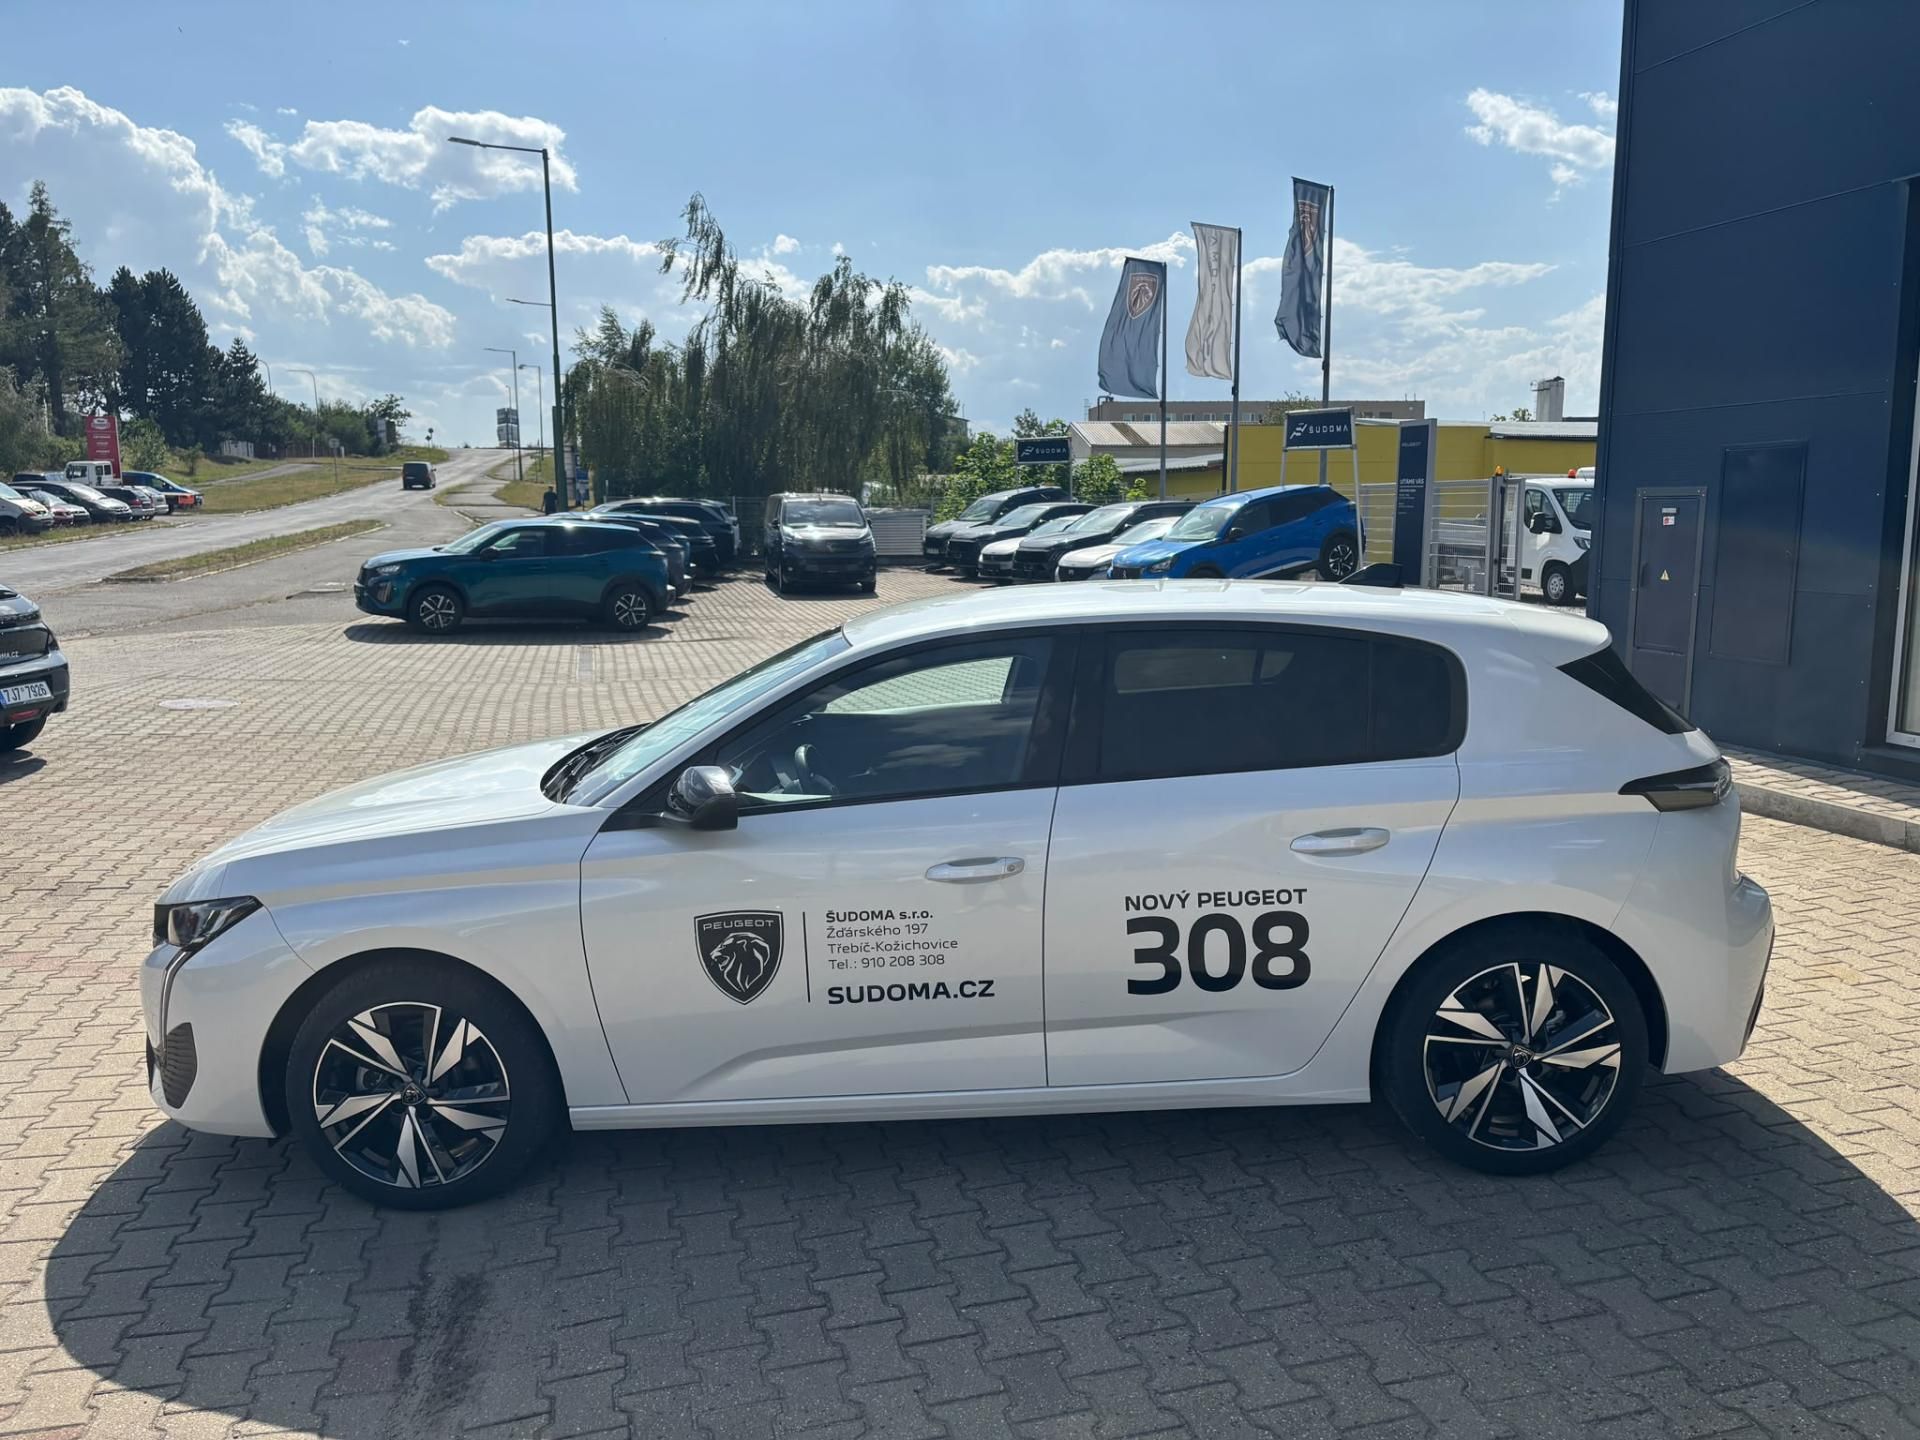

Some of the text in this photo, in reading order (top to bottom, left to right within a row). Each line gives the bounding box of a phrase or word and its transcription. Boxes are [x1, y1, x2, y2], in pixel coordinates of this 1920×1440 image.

[25, 683, 47, 698] 7926
[1125, 888, 1308, 911] NOVÝ PEUGEOT
[825, 910, 934, 923] ŠUDOMA s.r.o.
[703, 919, 774, 931] PEUGEOT
[826, 923, 928, 939] Žďárského 197
[1126, 910, 1312, 995] 308
[828, 954, 945, 970] Tel.: 910 208 308
[827, 979, 996, 1005] SUDOMA.CZ
